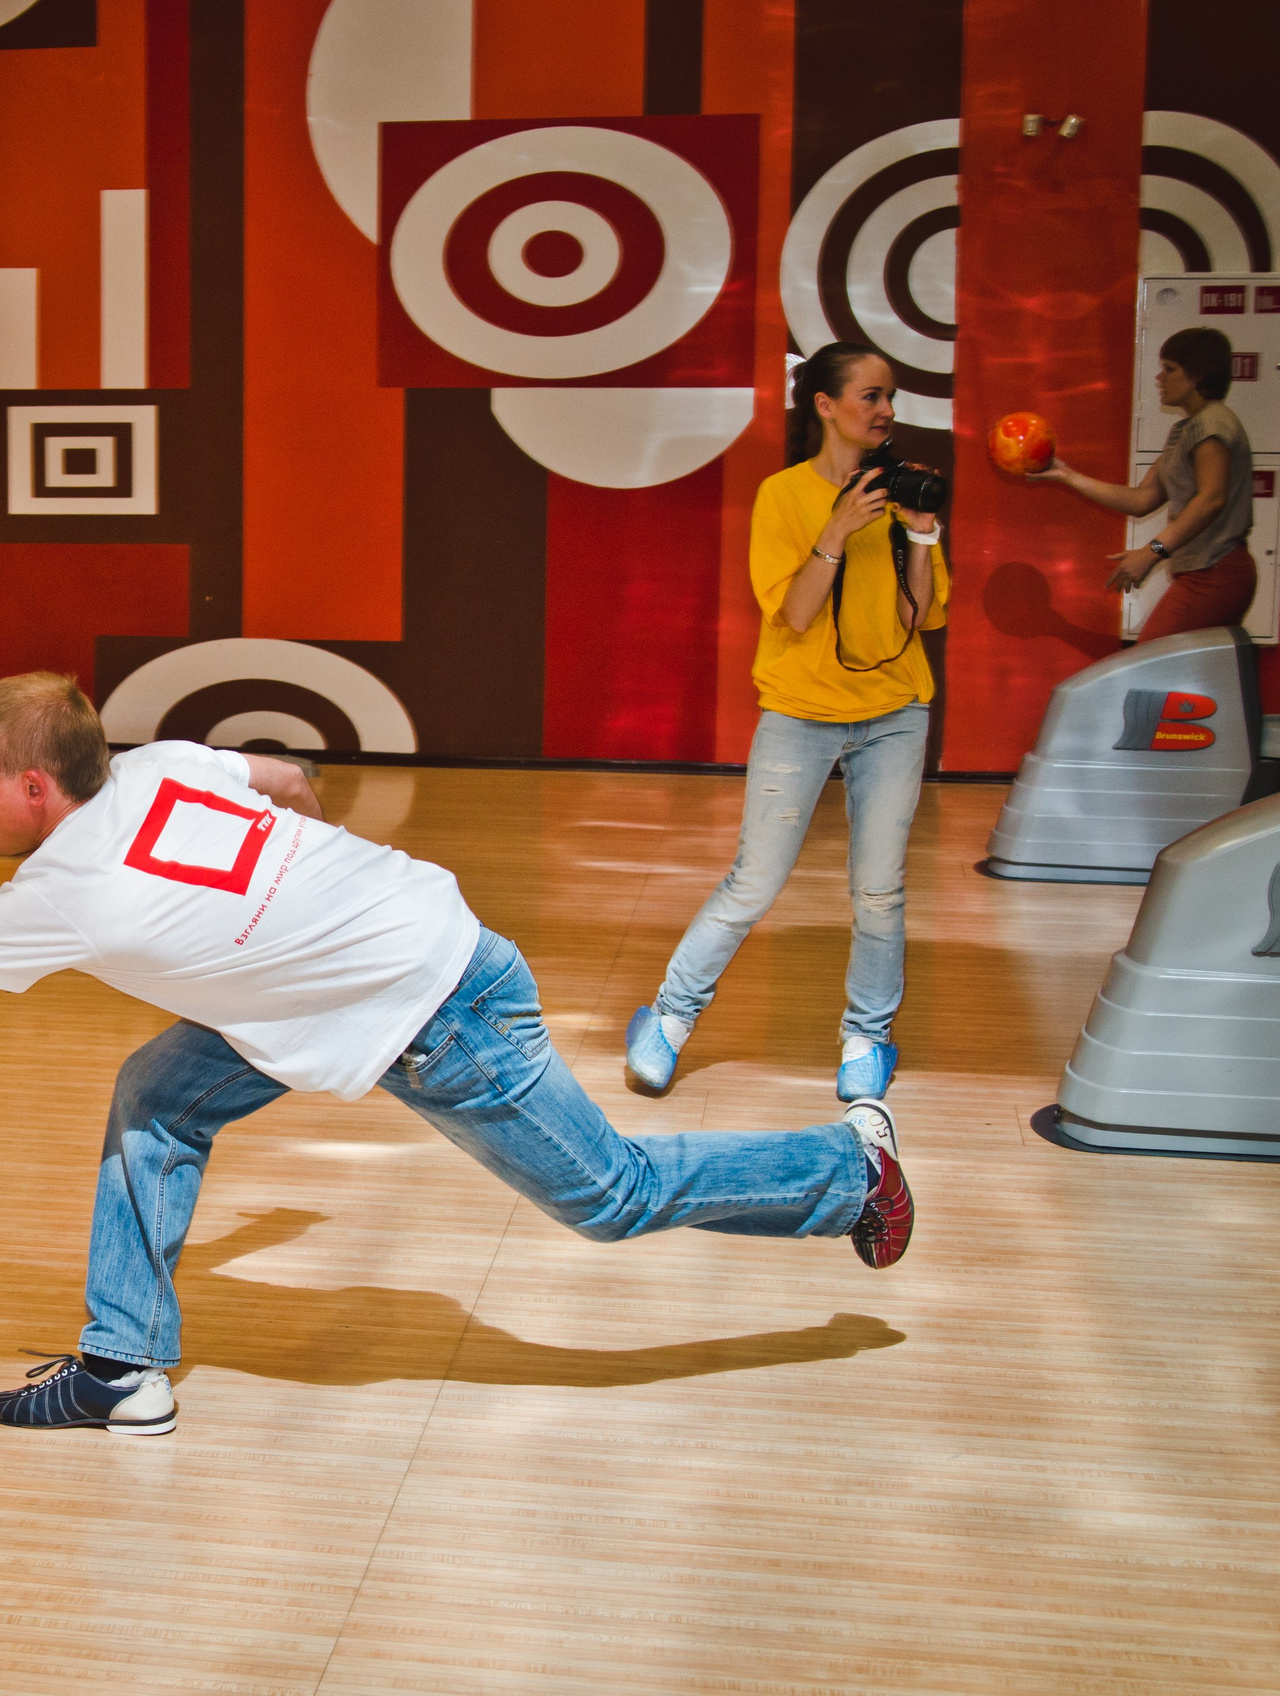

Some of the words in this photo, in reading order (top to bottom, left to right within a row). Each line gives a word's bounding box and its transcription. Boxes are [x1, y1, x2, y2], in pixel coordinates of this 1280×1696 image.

[1155, 731, 1206, 741] Brunswick
[234, 903, 267, 946] Взгляни
[265, 886, 277, 902] на
[274, 864, 289, 885] мир
[284, 849, 297, 864] под
